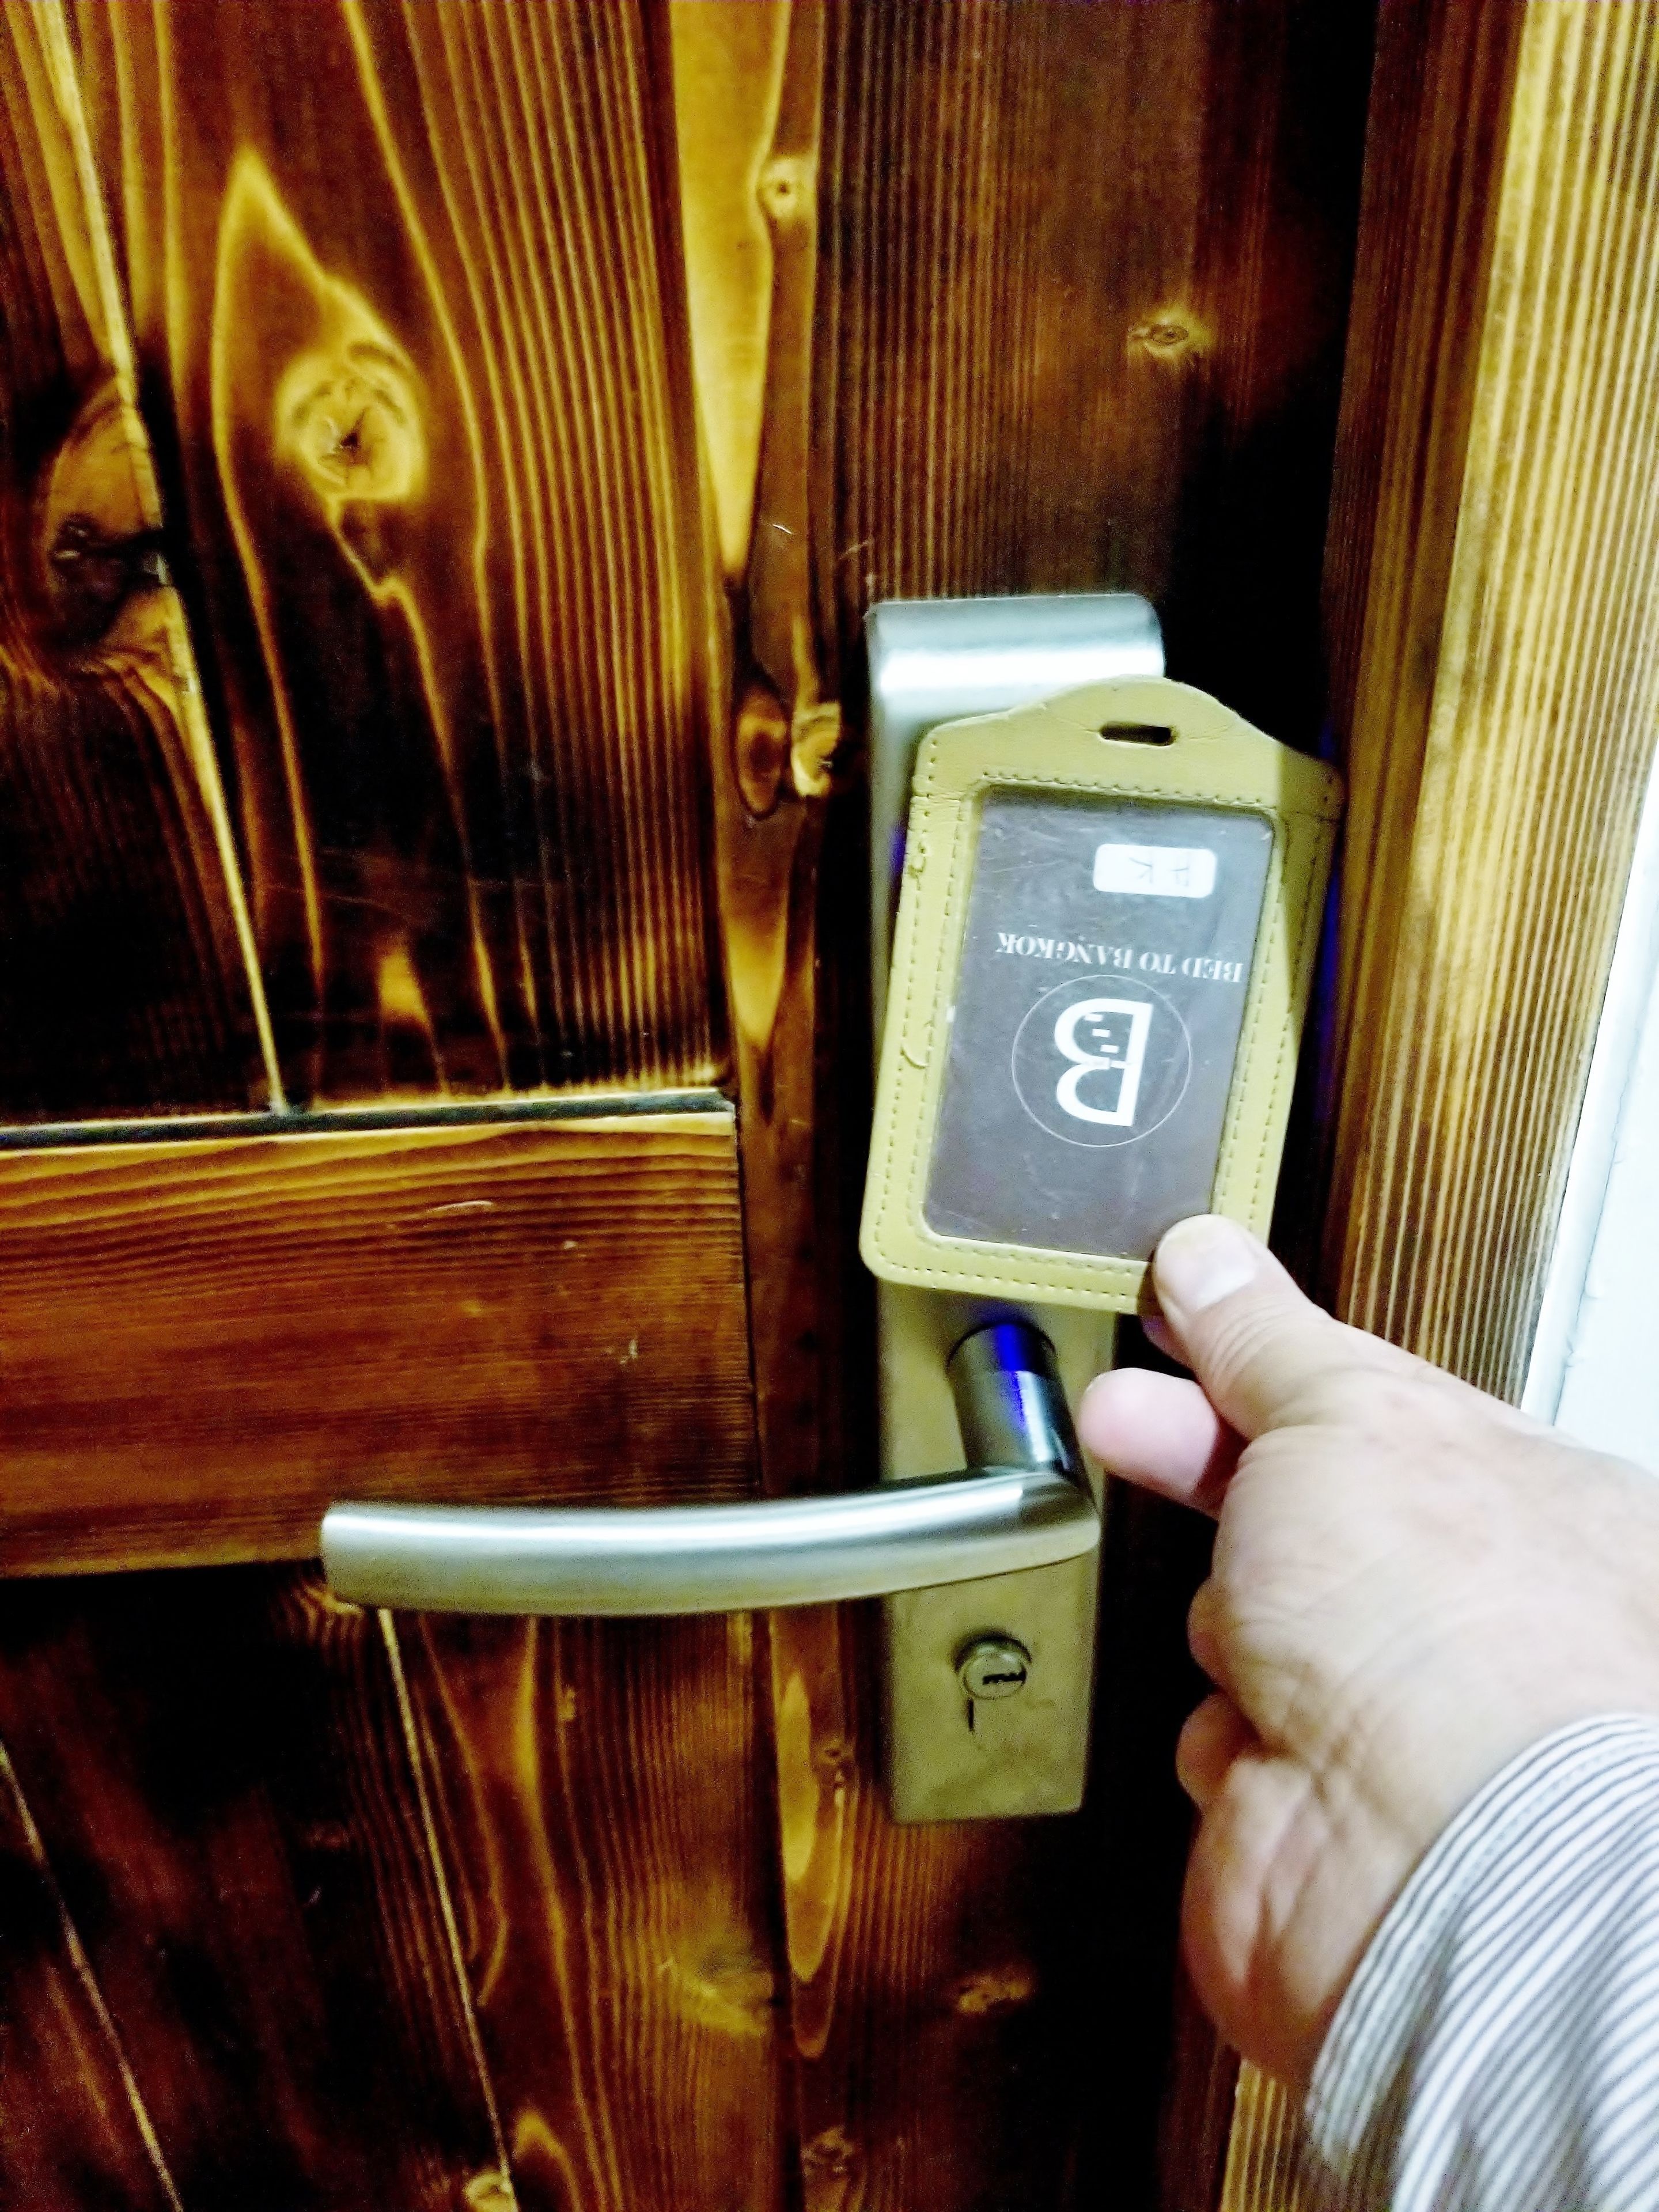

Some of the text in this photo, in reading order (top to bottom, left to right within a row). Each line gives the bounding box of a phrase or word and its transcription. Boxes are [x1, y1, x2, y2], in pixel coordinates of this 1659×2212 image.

[995, 932, 1244, 982] BED TO BANGKOK
[1054, 998, 1154, 1127] B
